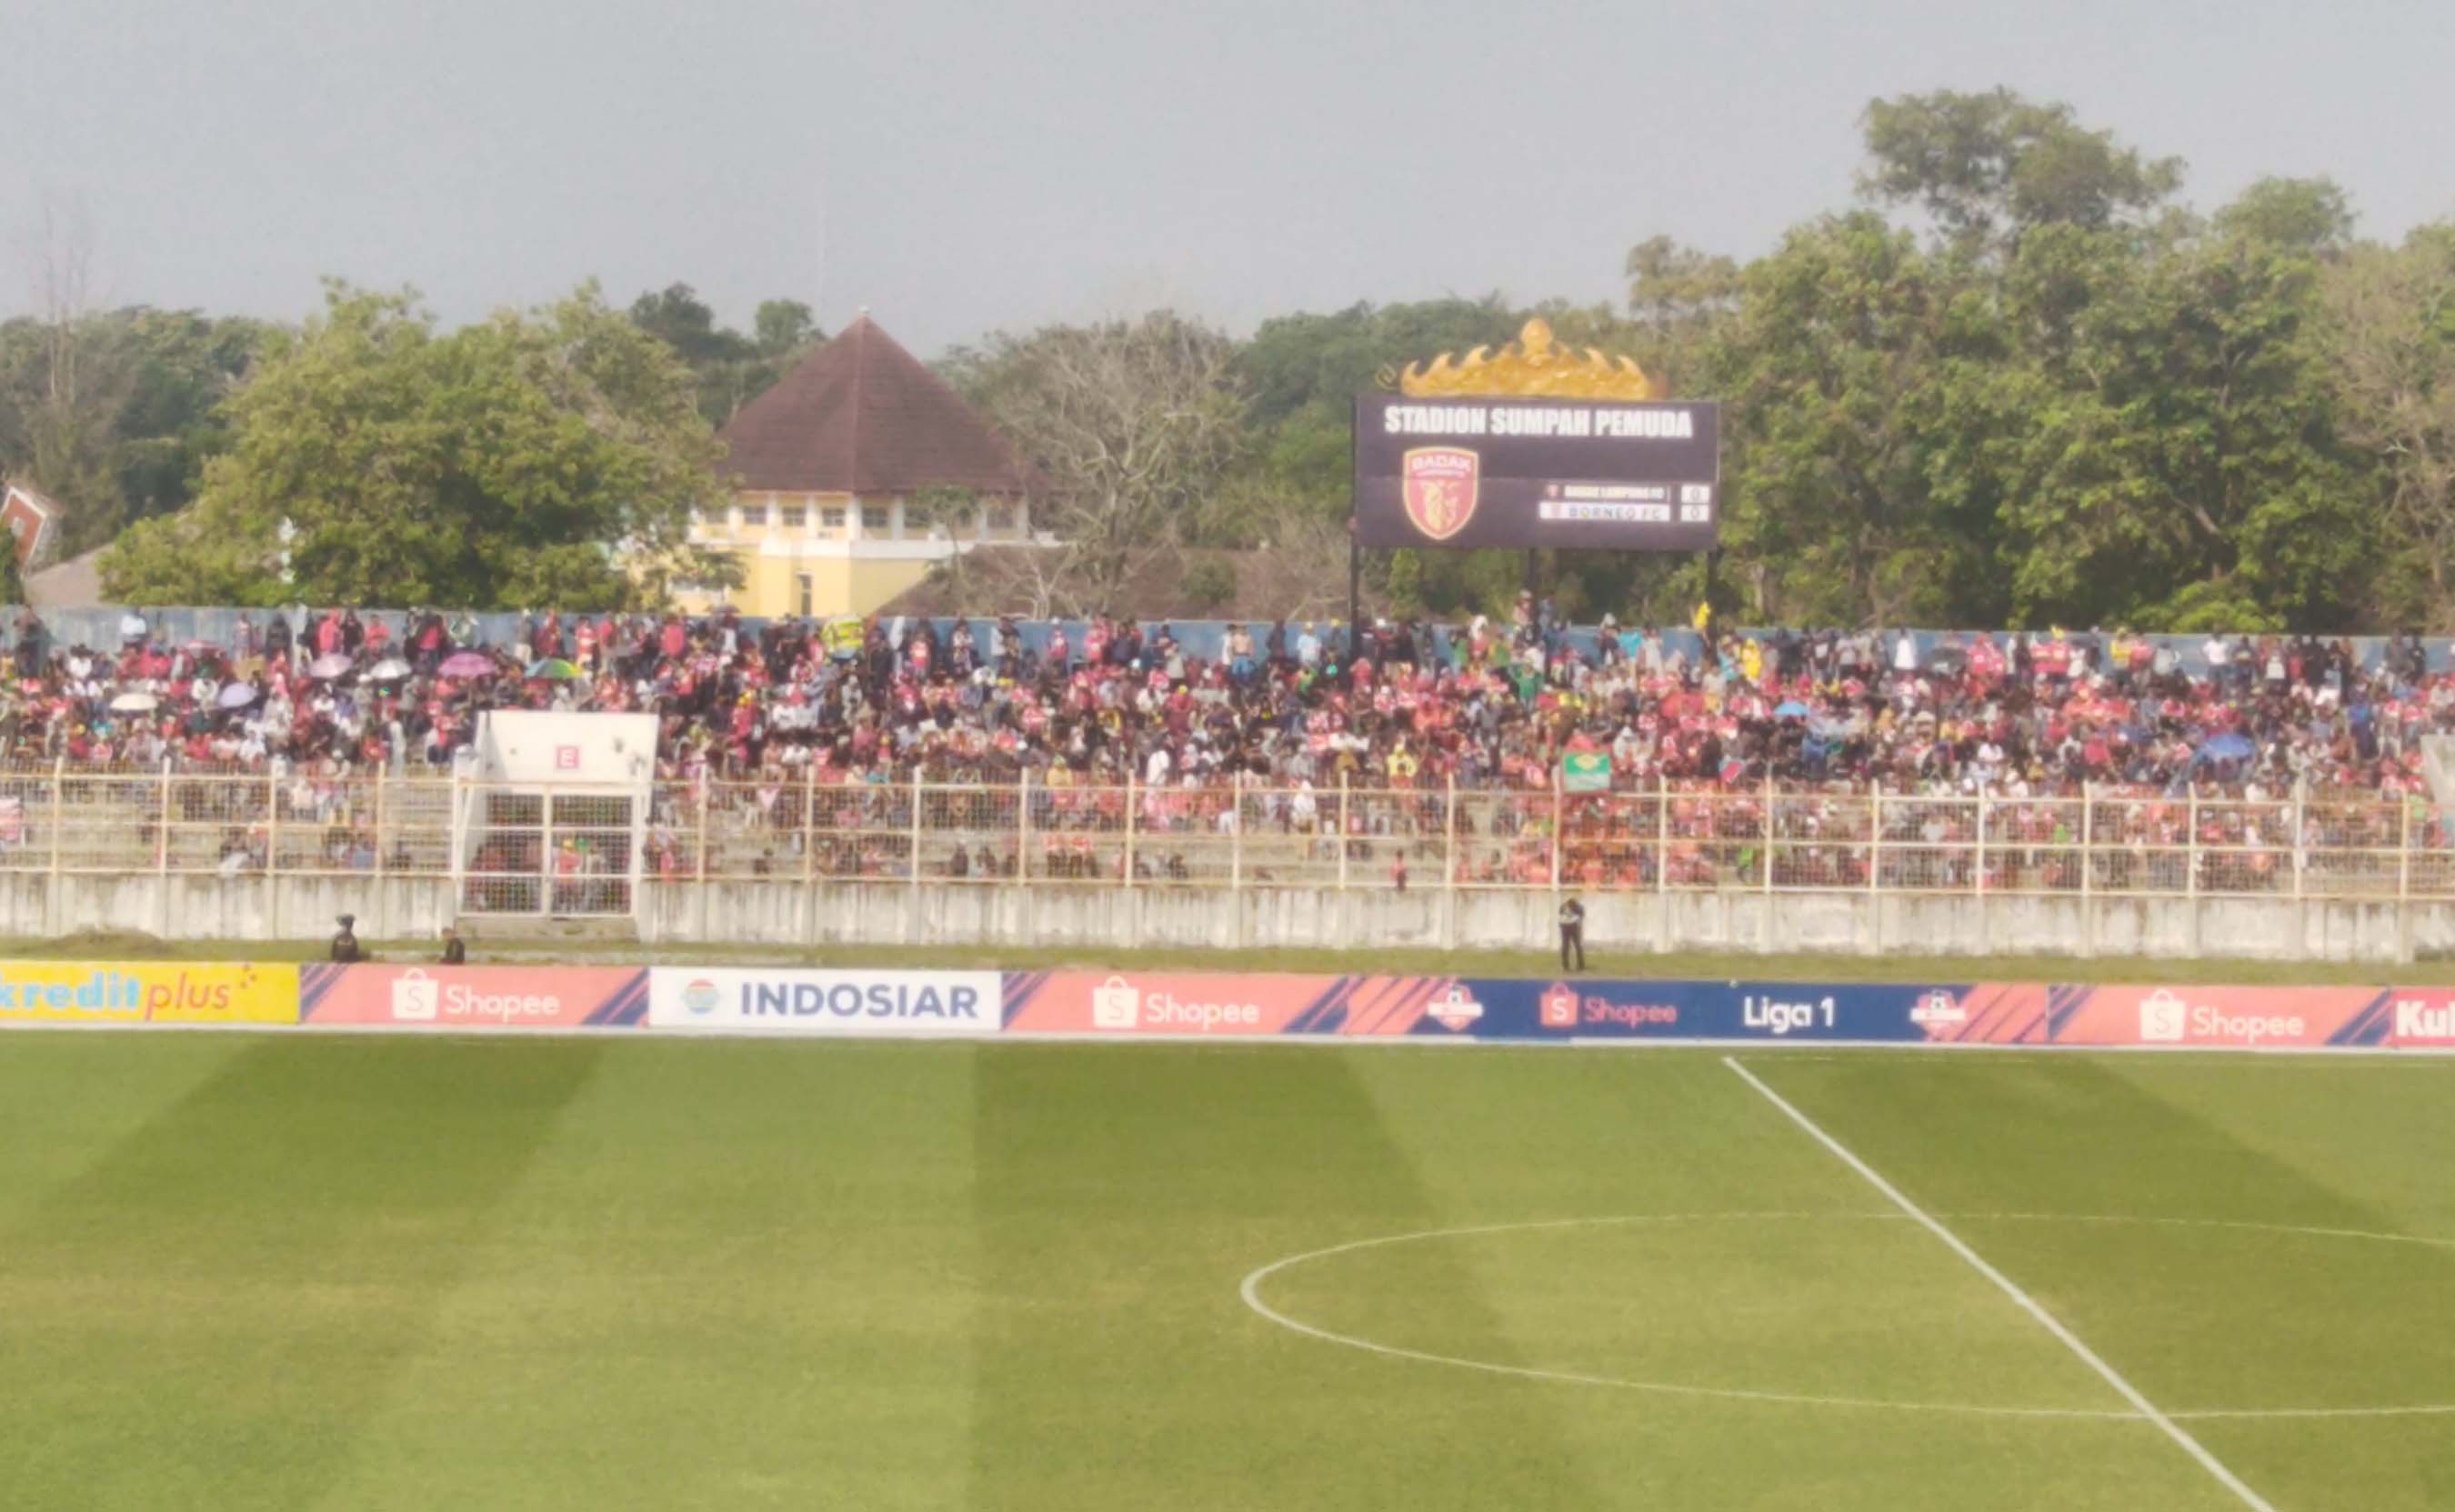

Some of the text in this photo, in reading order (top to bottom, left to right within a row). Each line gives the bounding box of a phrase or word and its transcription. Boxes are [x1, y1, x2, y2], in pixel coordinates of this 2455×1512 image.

[1384, 406, 1693, 437] STADION SUMPAH PEMUDA
[1568, 506, 1635, 520] BORNEO
[560, 751, 576, 766] E
[145, 972, 230, 1021] plus
[445, 986, 561, 1023] Shopee
[741, 982, 978, 1019] INDOSIAR
[1146, 993, 1260, 1029] Shopee
[1585, 997, 1677, 1028] Shopee
[1743, 997, 1834, 1033] Liga 1
[2191, 1006, 2304, 1043] Shopee
